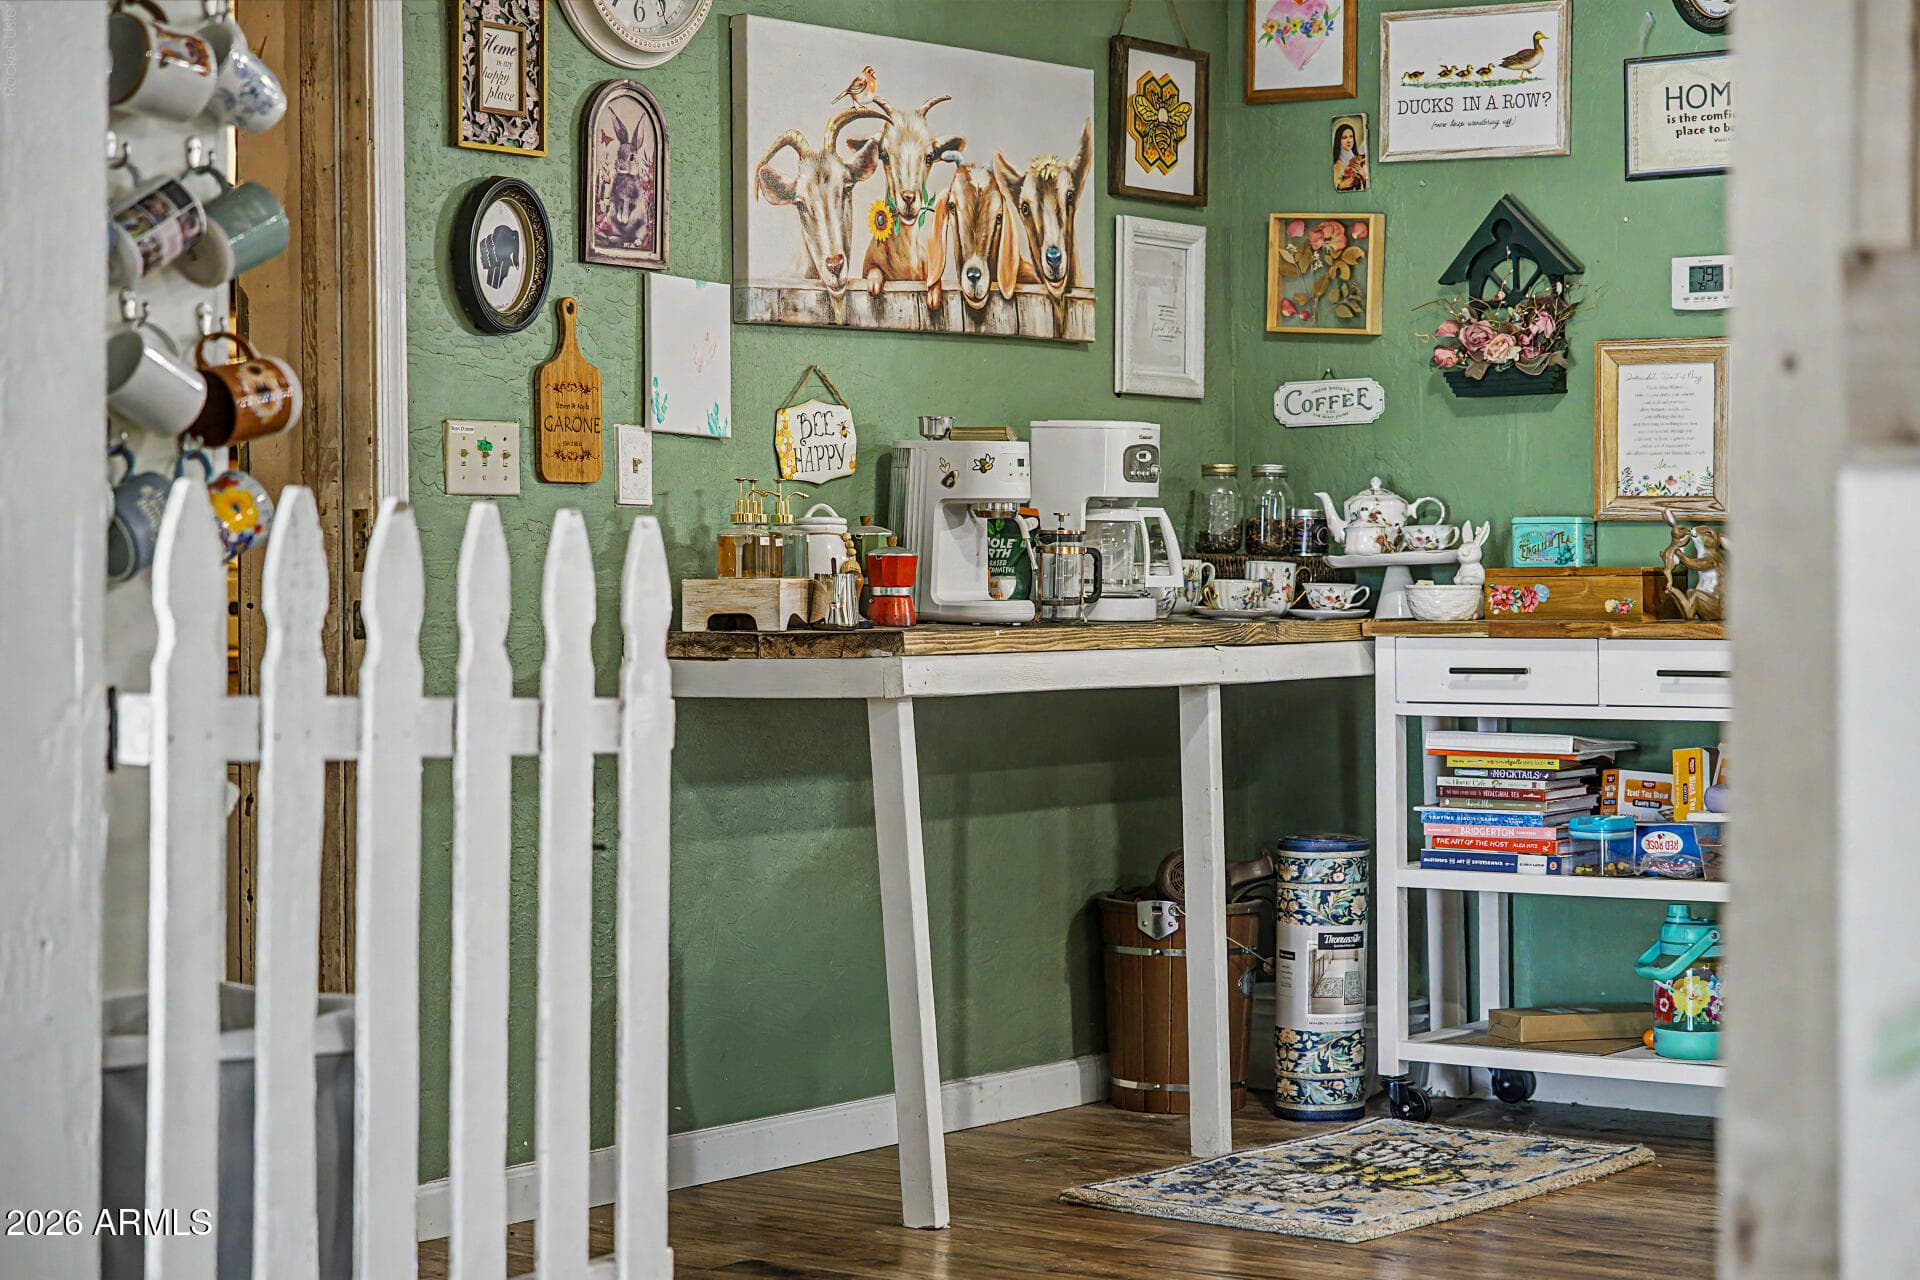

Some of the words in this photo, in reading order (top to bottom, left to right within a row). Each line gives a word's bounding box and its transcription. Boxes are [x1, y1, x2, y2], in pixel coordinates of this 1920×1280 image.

[483, 32, 517, 56] Home
[483, 66, 510, 85] happy
[485, 85, 515, 104] place
[1397, 97, 1454, 115] DUCKS
[1462, 96, 1481, 112] IN
[1485, 95, 1499, 110] A
[1502, 91, 1552, 109] ROW?
[1665, 81, 1732, 112] HOM
[1667, 114, 1676, 124] is
[1679, 112, 1698, 123] the
[1676, 125, 1706, 139] place
[1709, 125, 1721, 134] to
[1723, 122, 1735, 133] b
[1284, 387, 1374, 416] COFFEE
[543, 415, 601, 434] GARONE
[796, 410, 836, 447] BEE
[793, 442, 847, 473] HAPPY
[988, 537, 1018, 548] OLE
[989, 548, 1012, 558] RTH
[1492, 769, 1540, 780] MOCKTAILS
[1459, 825, 1515, 838] BRIDGERTON
[1489, 840, 1509, 848] HOST
[1645, 839, 1664, 850] ROSE
[1665, 839, 1679, 851] RED
